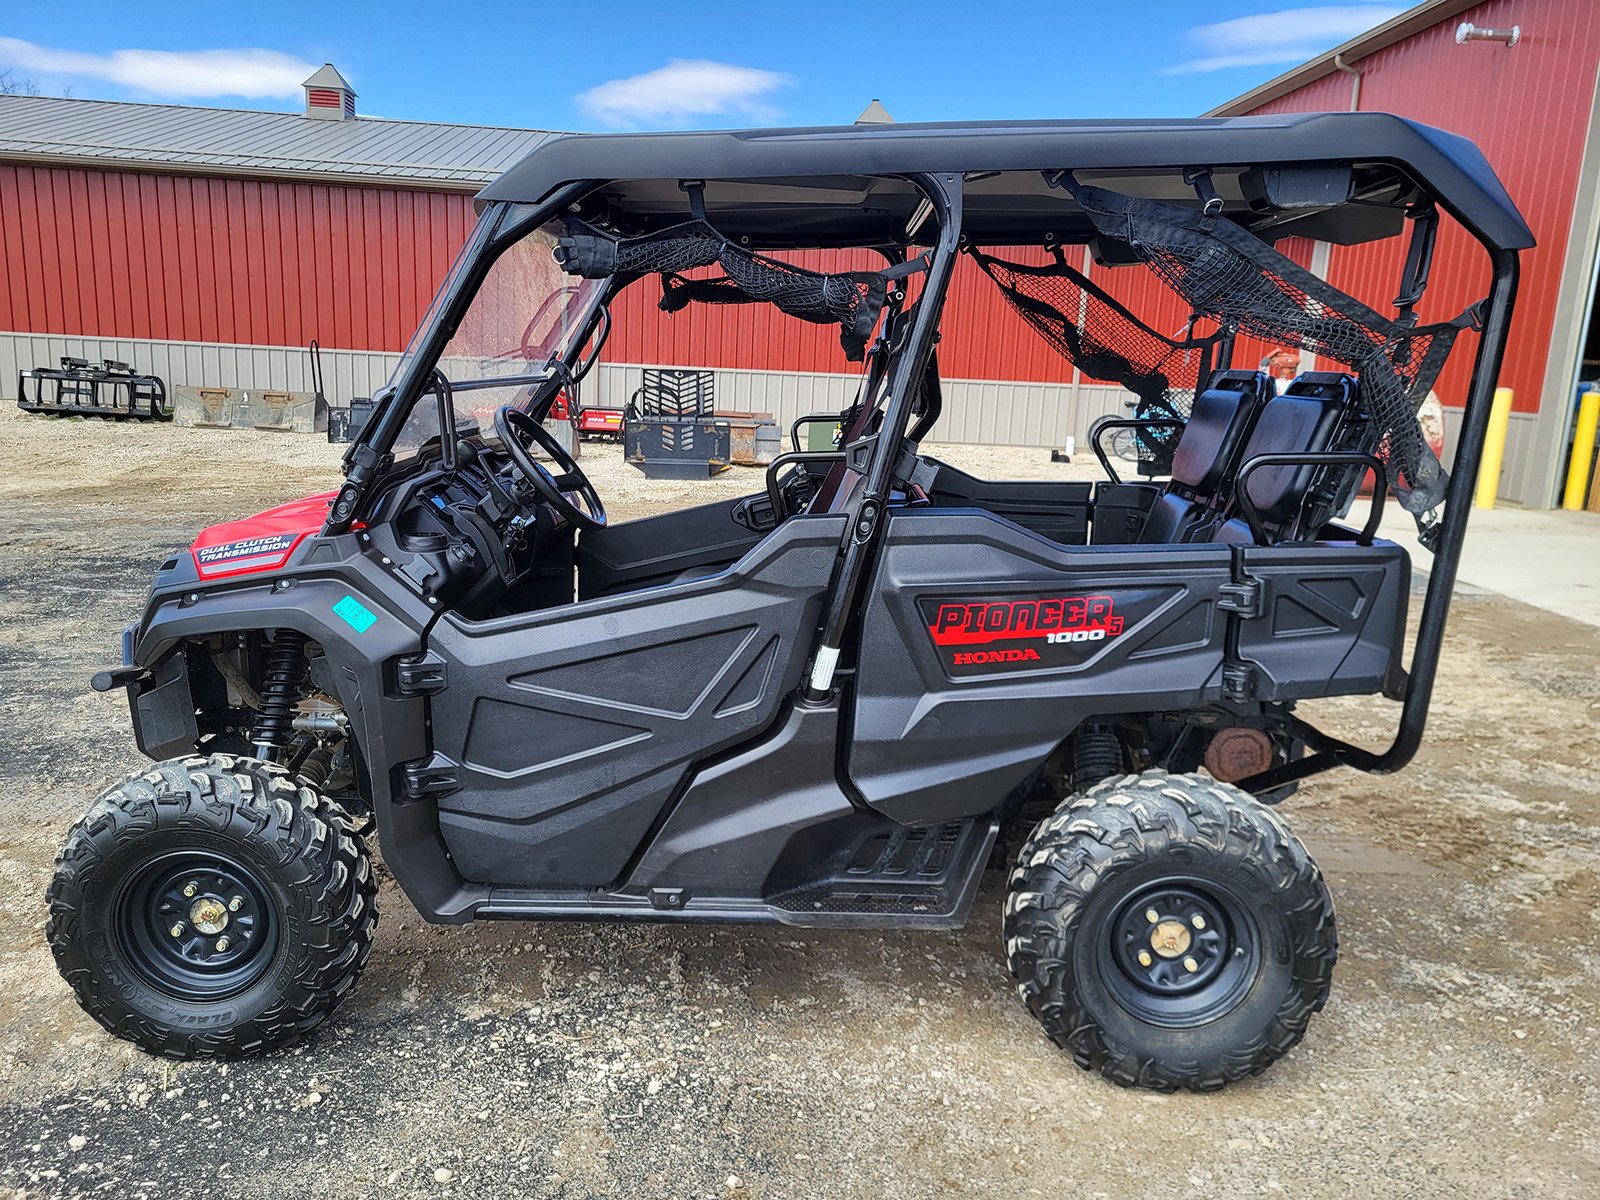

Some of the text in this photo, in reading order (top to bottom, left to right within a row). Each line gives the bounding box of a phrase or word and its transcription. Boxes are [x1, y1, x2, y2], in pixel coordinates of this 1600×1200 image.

[200, 536, 282, 556] DUAL CLUTCH
[200, 541, 291, 562] TRANSMISSION
[937, 595, 1113, 634] PIONEER
[1047, 629, 1105, 644] 1000
[953, 649, 1040, 665] HONDA
[171, 1010, 233, 1024] BLACK
